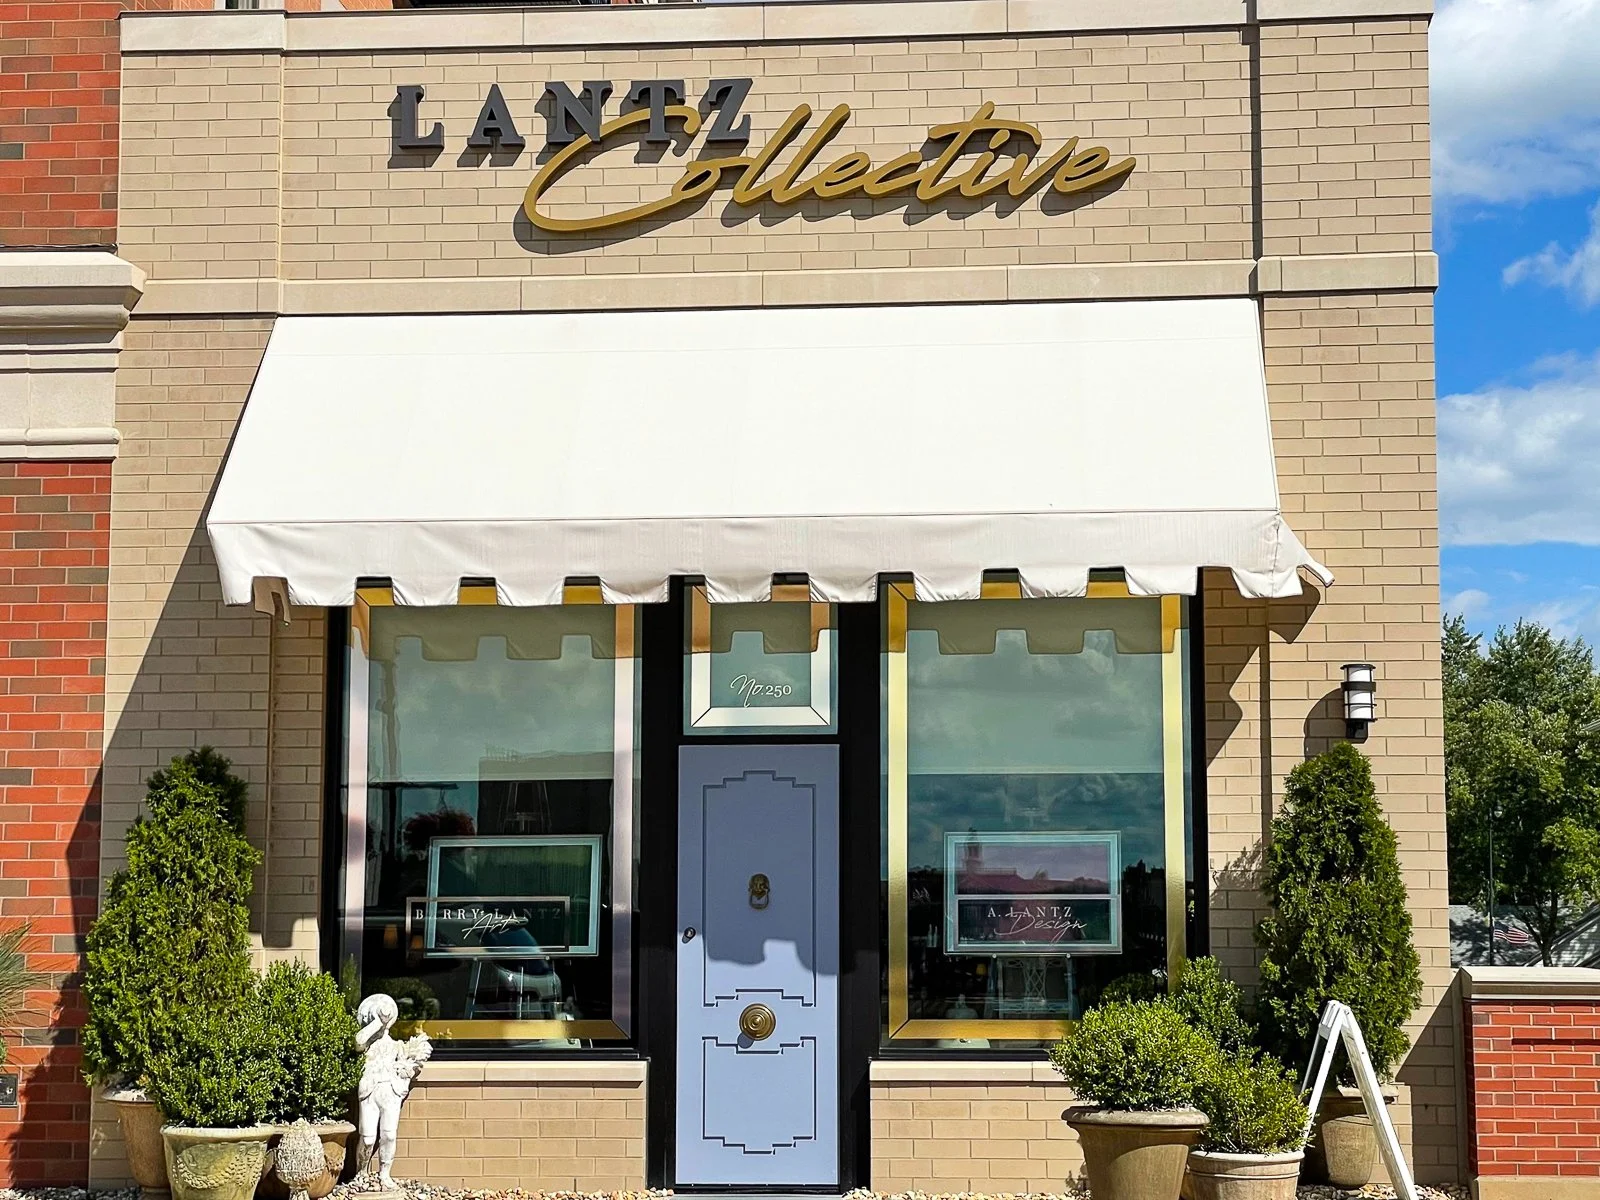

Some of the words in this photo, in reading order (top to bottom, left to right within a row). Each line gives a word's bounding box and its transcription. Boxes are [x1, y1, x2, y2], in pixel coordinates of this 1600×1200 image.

[396, 77, 753, 149] LANTZ
[523, 101, 1136, 233] Collective
[461, 912, 520, 940] Art
[987, 906, 1001, 918] A.
[1009, 906, 1072, 918] LANTZ
[993, 911, 1087, 948] Design
